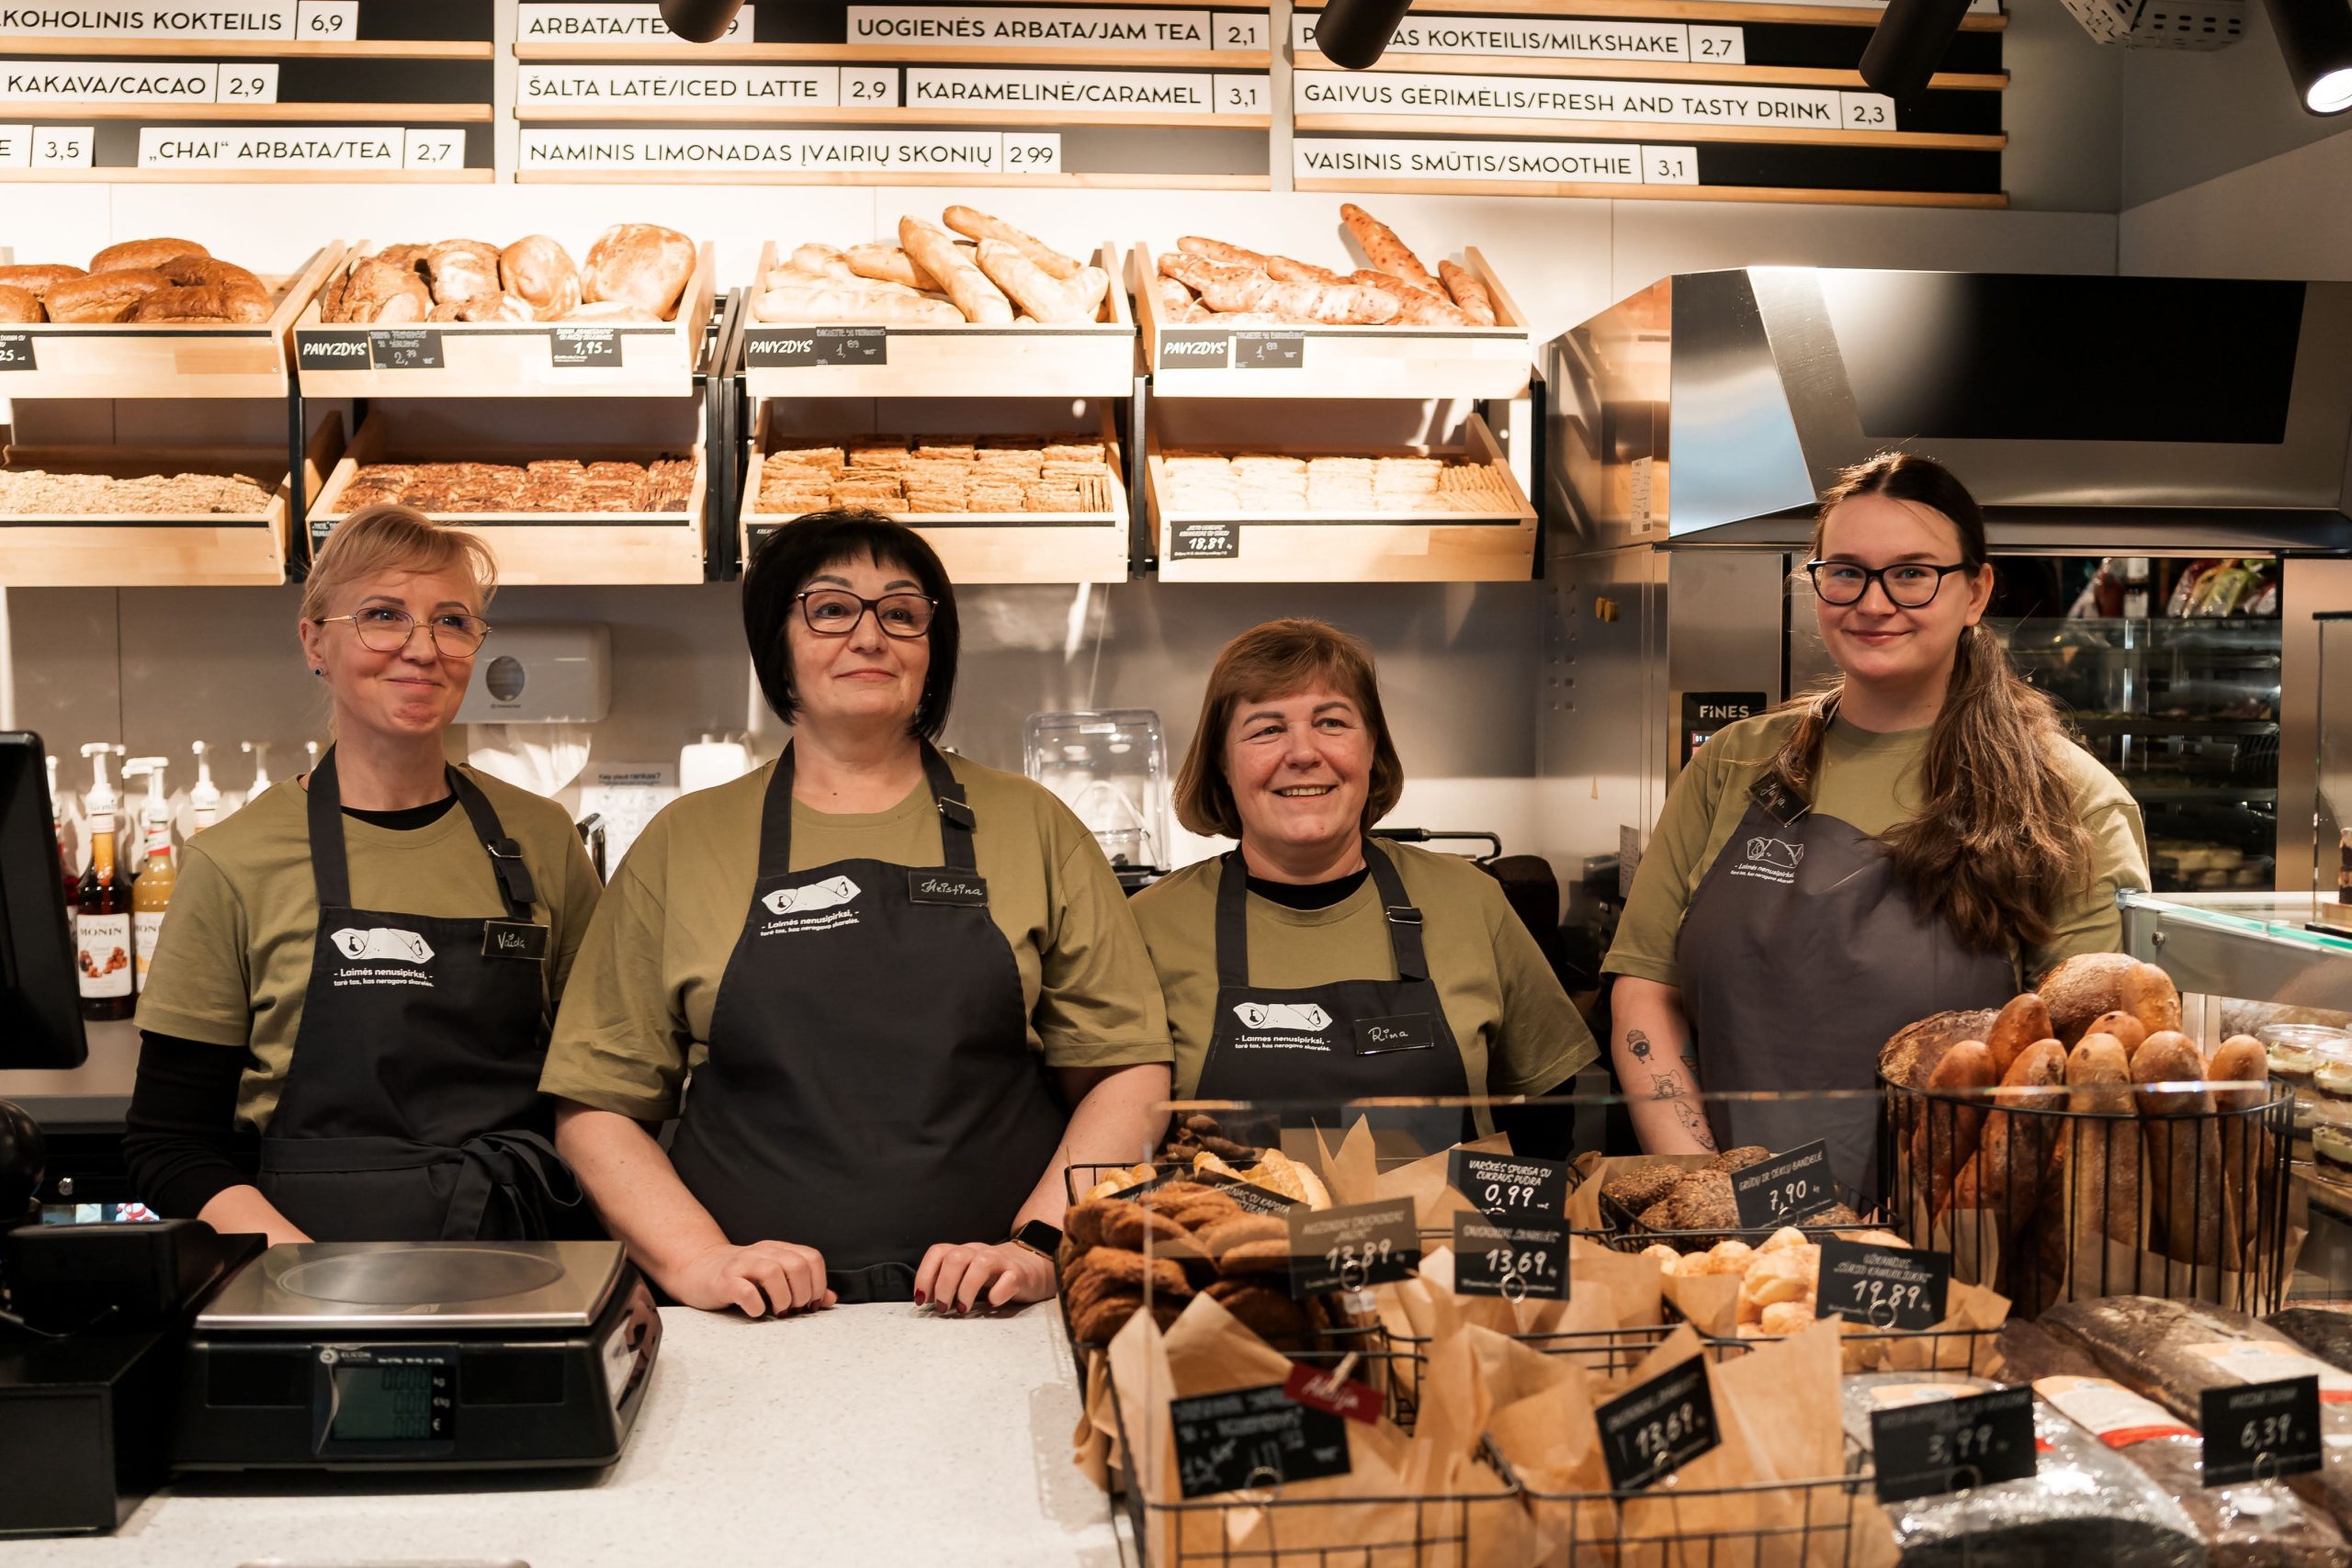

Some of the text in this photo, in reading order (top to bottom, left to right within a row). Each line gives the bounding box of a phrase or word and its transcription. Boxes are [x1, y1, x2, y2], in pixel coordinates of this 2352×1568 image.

[0, 10, 344, 34] KOHOLINIS KOKTEILIS 6,9
[529, 17, 673, 35] ARBATA/TE
[857, 17, 1256, 46] UOGIENĖS ARBATA/JAM TEA 2,1
[1428, 30, 1679, 53] KOKTEILIS/MILKSHAKE
[1701, 39, 1733, 57] 2,7
[8, 75, 266, 97] KAKAVA/CACAO 2,9
[528, 75, 888, 100] ŠALTA LATĖ/ICED LATTE 2,9
[917, 81, 1257, 107] KARAMELINĖ/CARAMEL 3,1
[1304, 84, 1884, 126] GAIVUS GĖRIMĖLIS/FRESH AND TASTY DRINK 2,3
[44, 141, 80, 160] 3,5
[237, 141, 392, 159] ARBATA/TEA
[417, 143, 451, 163] 2,7
[530, 143, 636, 162] NAMINIS
[645, 144, 792, 163] LIMONADAS
[800, 144, 890, 167] ĮVAIRIŲ
[899, 145, 993, 168] SKONIŲ
[1304, 151, 1684, 178] VAISINIS SMŪTIS/SMOOTHIE 3,1
[302, 342, 368, 356] PAVYZDYS
[749, 340, 814, 355] PAVYZDYS
[1163, 341, 1227, 355] PAVYZDYS
[80, 926, 122, 936] MONIN
[497, 931, 526, 950] Vaida
[340, 967, 373, 977] Laimės
[374, 968, 428, 980] nenusipirksi,
[1272, 1035, 1325, 1045] nenusipirksi,
[1367, 1026, 1409, 1043] Rima
[1468, 1160, 1553, 1178] VARŠKĖS SPURGA SU
[1476, 1170, 1515, 1184] CUKRAUS
[1485, 1183, 1534, 1208] 0,99
[1769, 1179, 1807, 1211] 7,90
